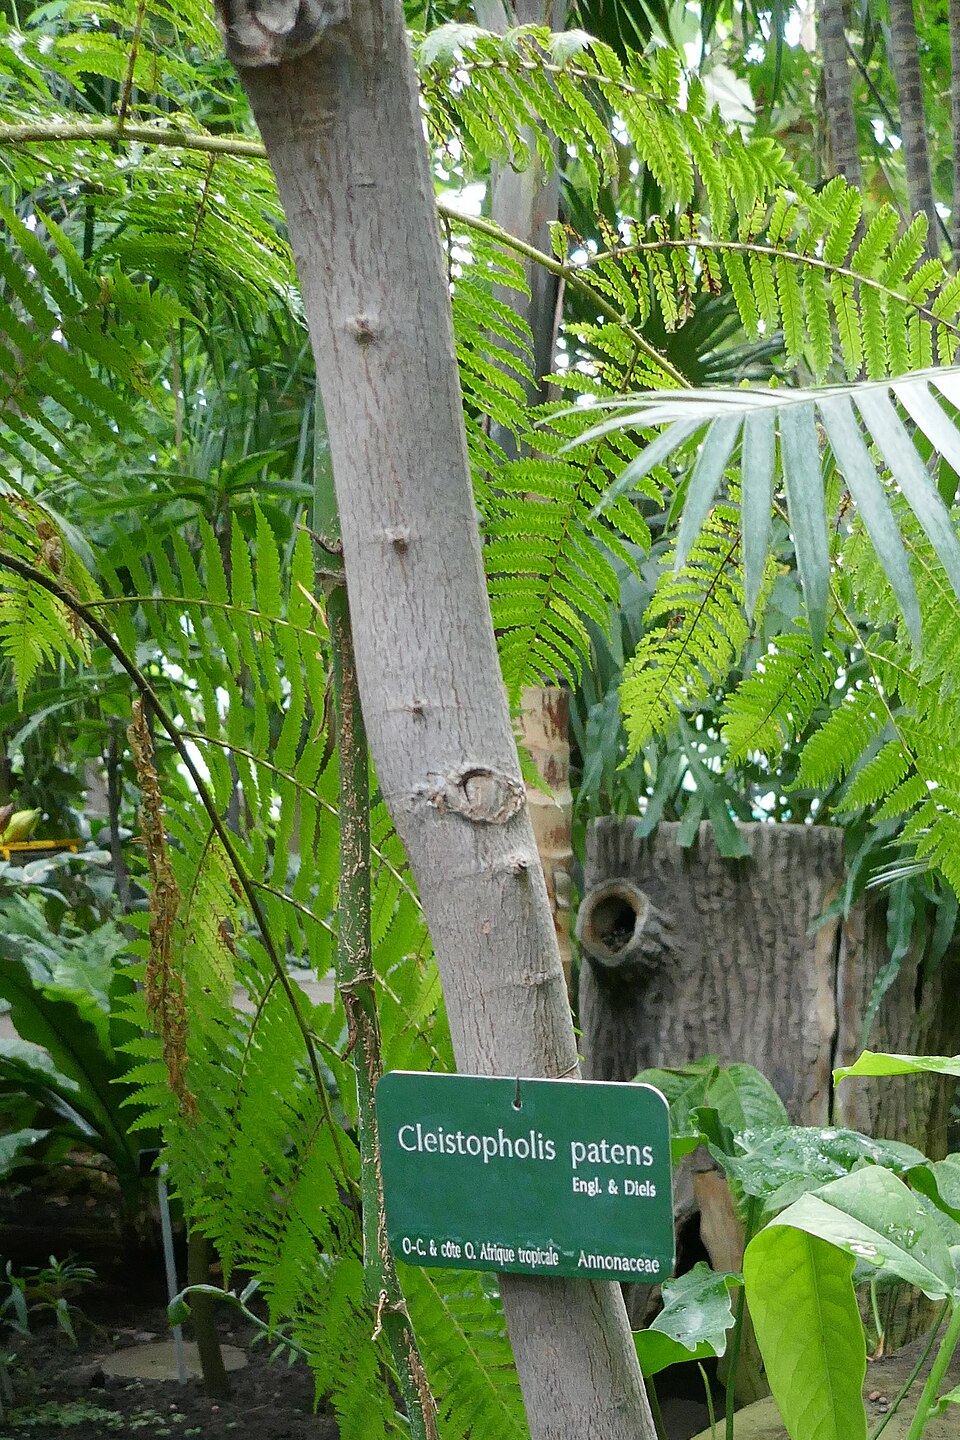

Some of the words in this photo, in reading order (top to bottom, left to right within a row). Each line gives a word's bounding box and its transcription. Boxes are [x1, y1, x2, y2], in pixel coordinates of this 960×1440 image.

[398, 1123, 556, 1163] Cleistopholis
[571, 1139, 653, 1169] patens
[573, 1177, 602, 1197] Engl.
[608, 1179, 618, 1195] &
[625, 1179, 656, 1198] Diels
[430, 1239, 437, 1257] &
[441, 1240, 461, 1259] côte
[465, 1242, 476, 1260] O.
[480, 1242, 515, 1265] Afrique
[518, 1247, 559, 1268] tropicale
[578, 1250, 660, 1273] Annonaceae
